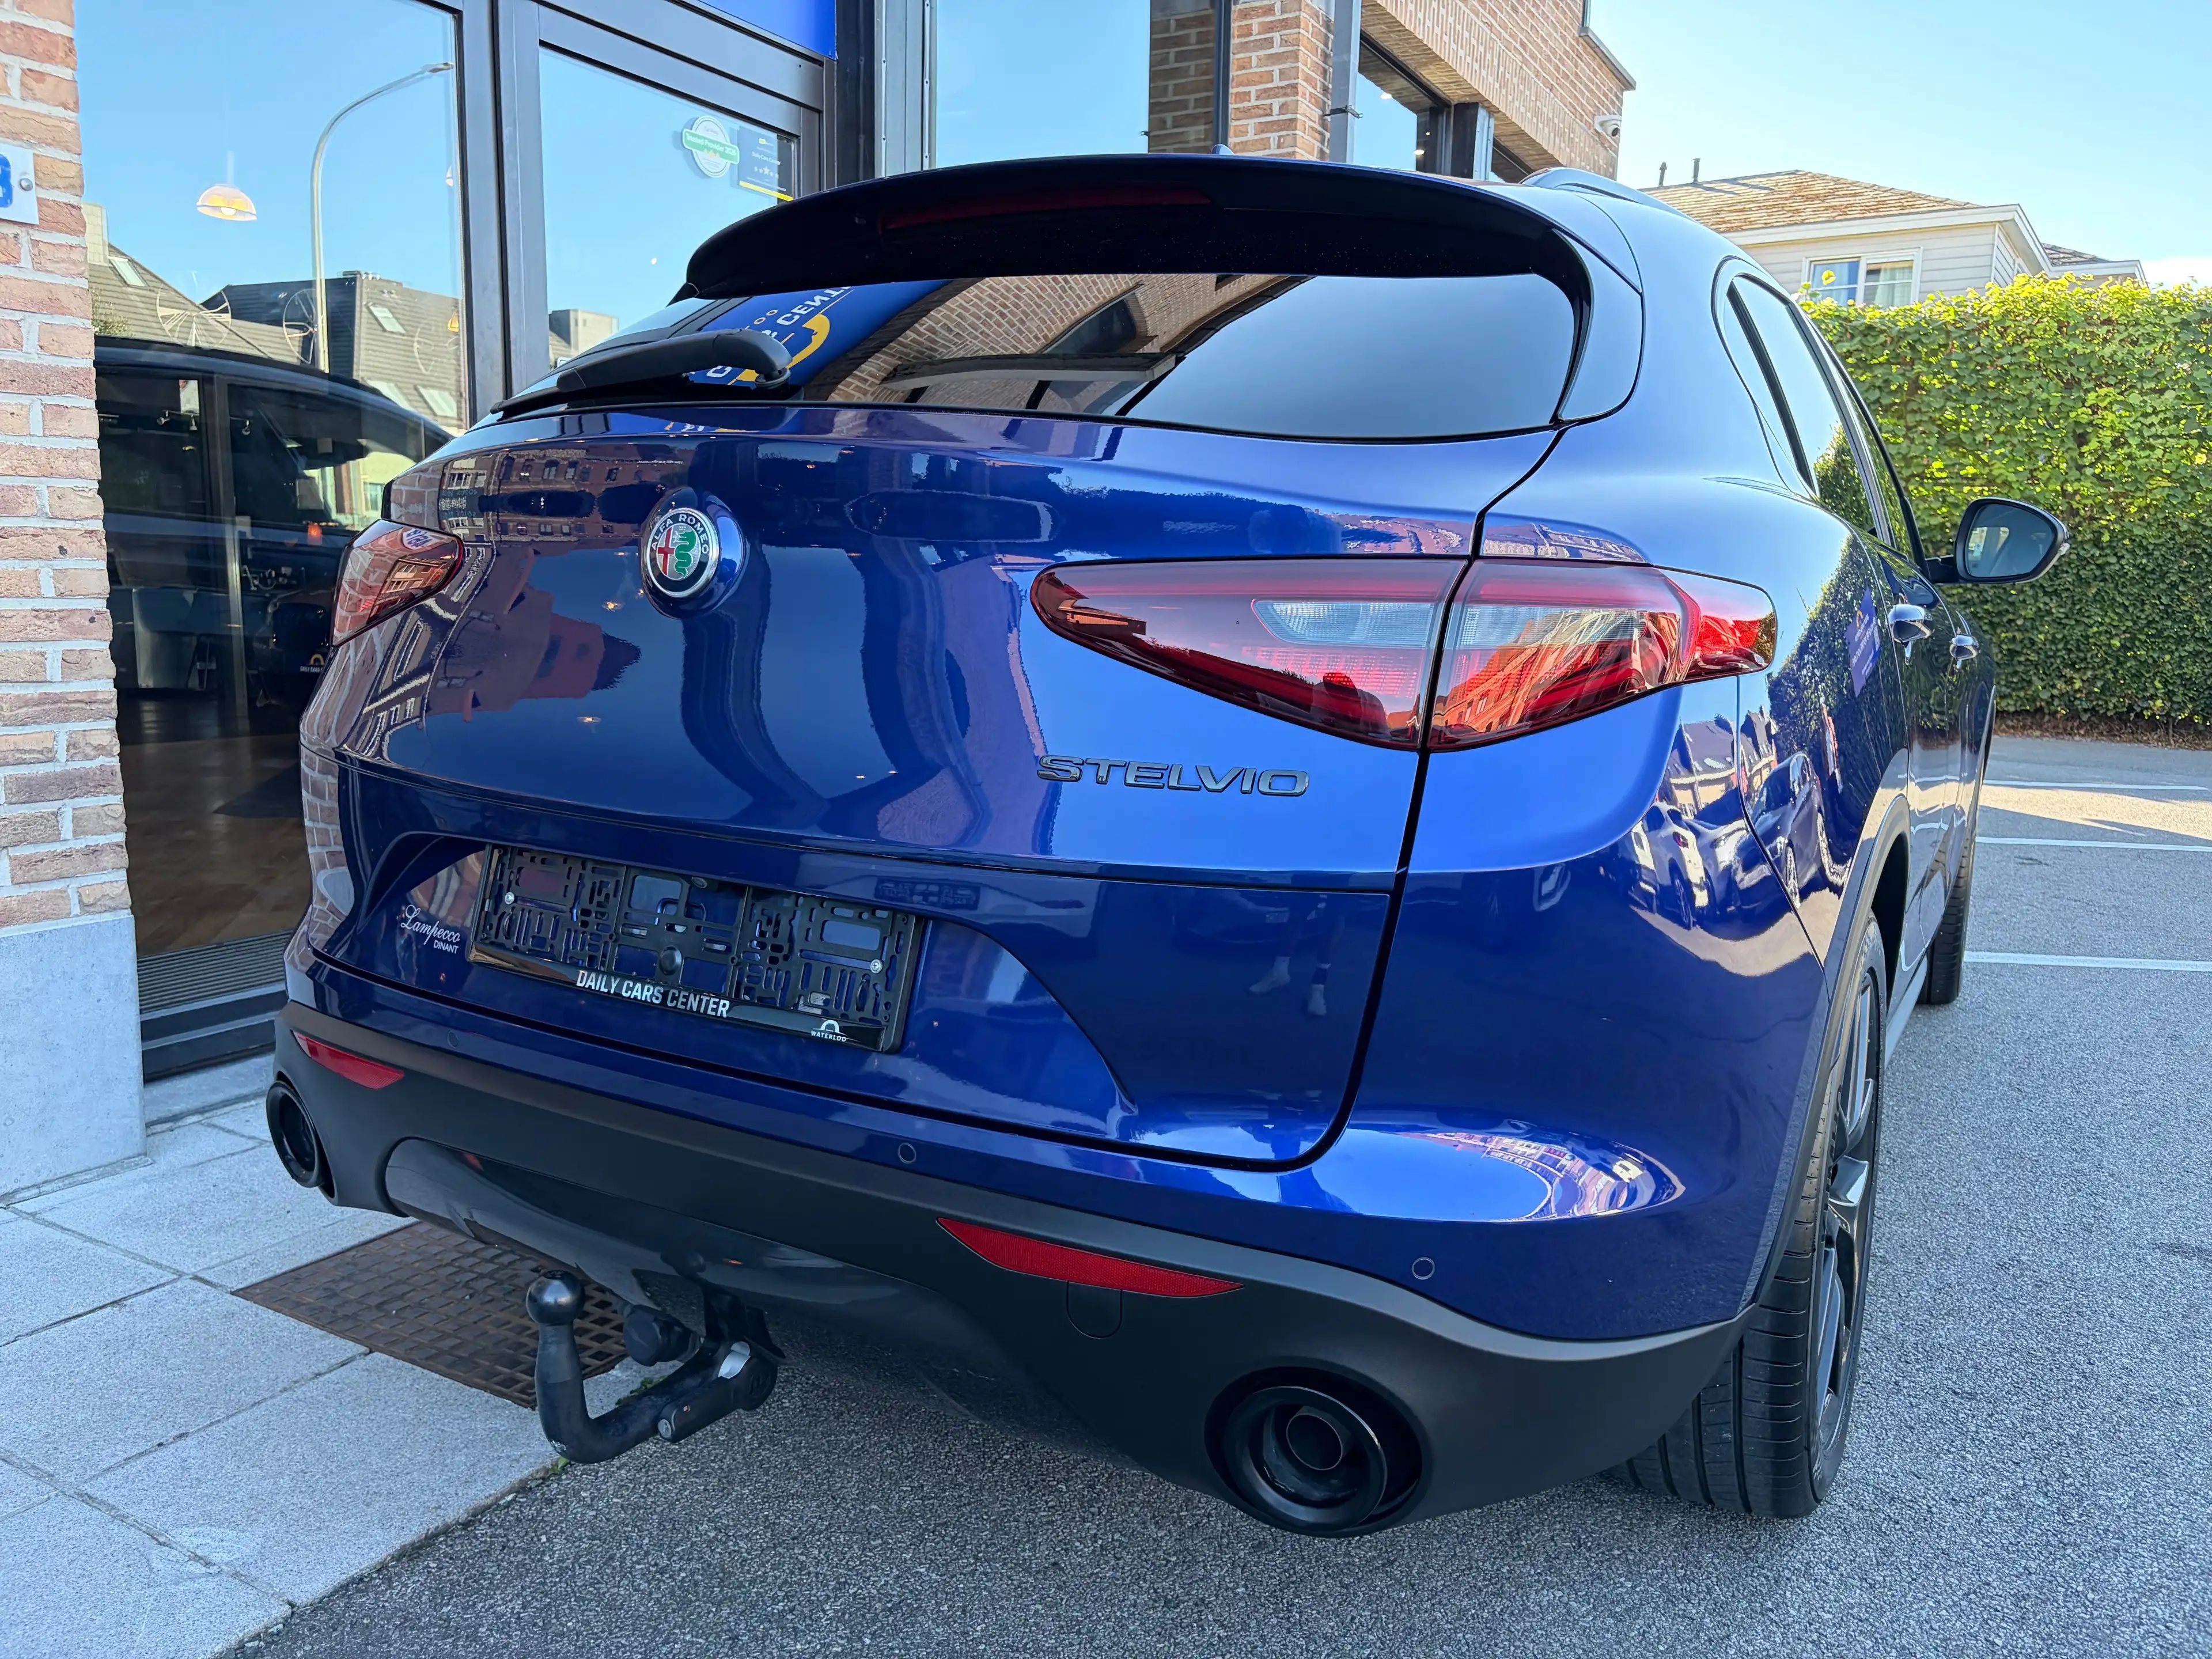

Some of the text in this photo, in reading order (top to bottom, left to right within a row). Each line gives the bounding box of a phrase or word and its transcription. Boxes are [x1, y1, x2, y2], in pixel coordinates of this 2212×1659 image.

[652, 514, 709, 554] ALFA ROMEO
[1036, 754, 1310, 797] STELVIO
[400, 904, 461, 945] Lampecco
[433, 940, 459, 955] DINANT
[576, 969, 730, 1018] DAILY CARS CENTER
[810, 1030, 847, 1042] WATERLOO
